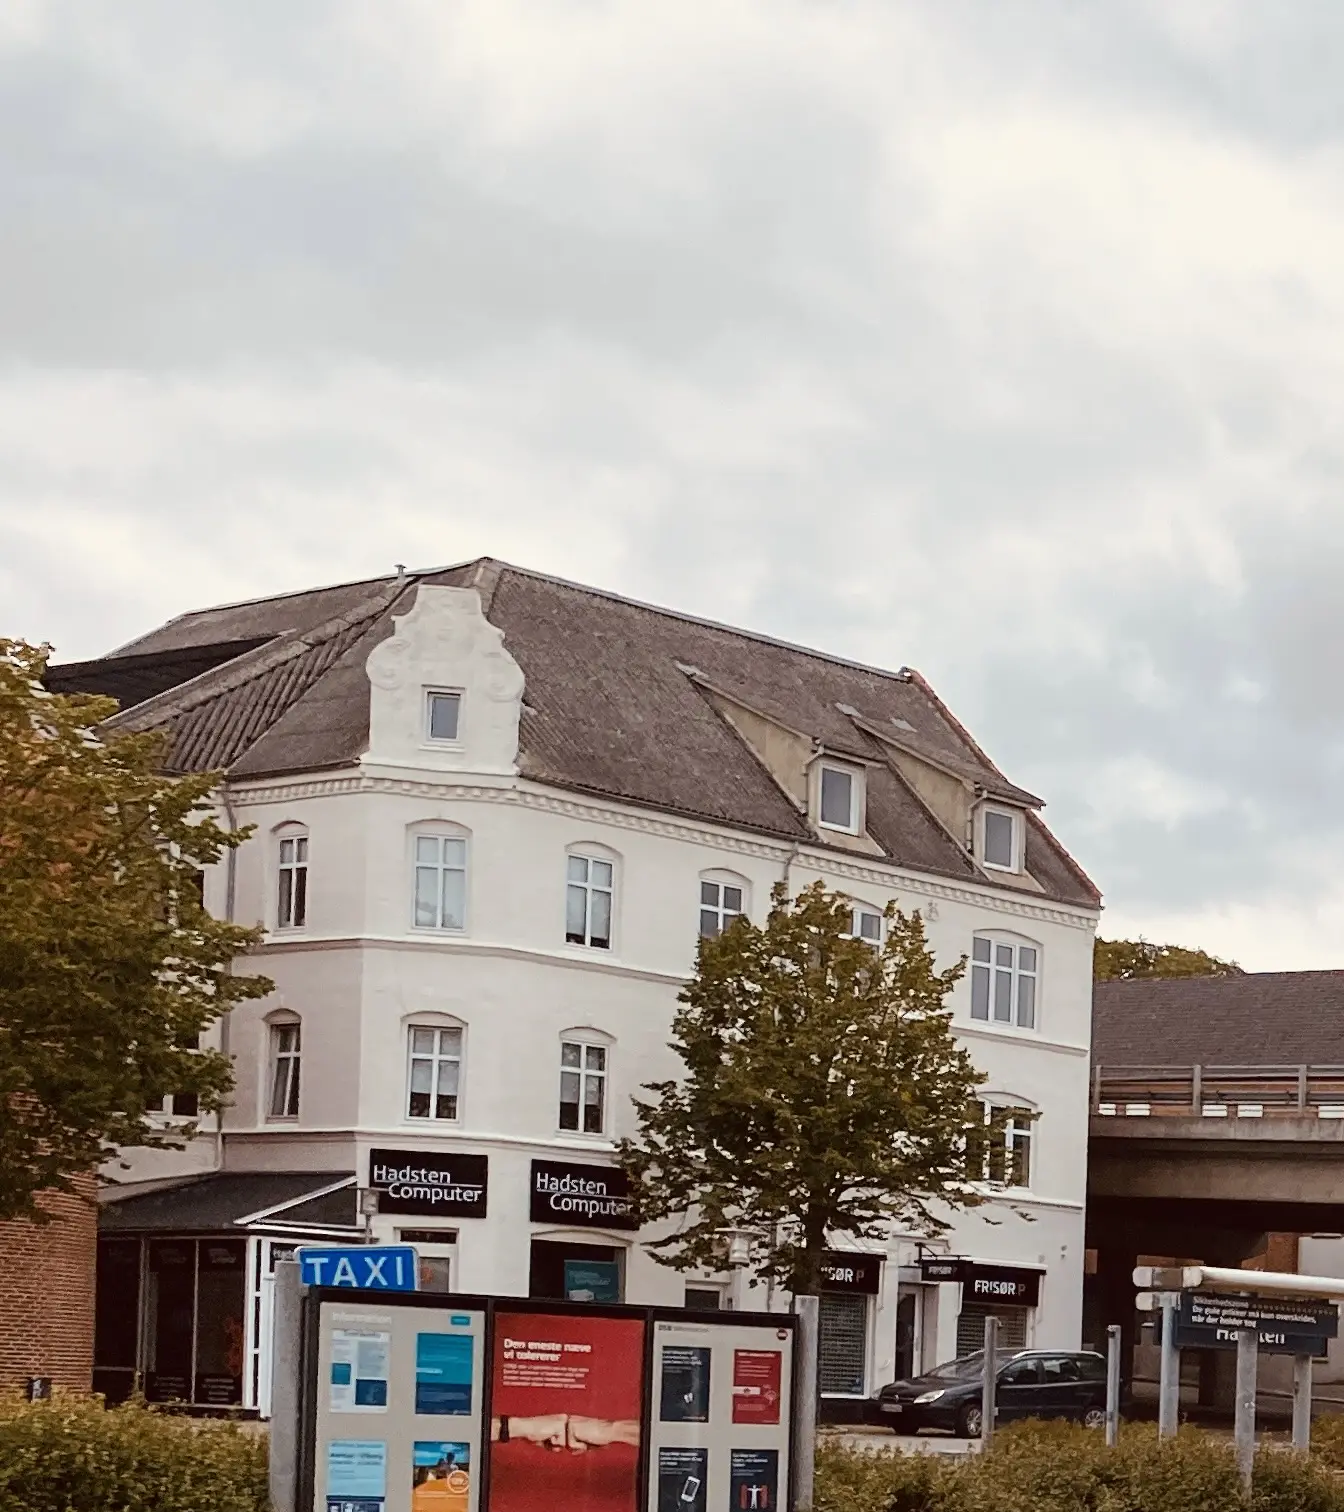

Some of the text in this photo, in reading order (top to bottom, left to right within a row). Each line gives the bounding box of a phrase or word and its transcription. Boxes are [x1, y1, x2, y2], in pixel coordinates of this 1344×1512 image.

[373, 1165, 451, 1184] Hadsten
[536, 1172, 607, 1195] Hadsten
[388, 1183, 483, 1204] Computer
[305, 1256, 404, 1287] TAXI
[974, 1280, 1016, 1295] FRISØR
[503, 1338, 526, 1350] Den
[1216, 1328, 1285, 1345] Haten
